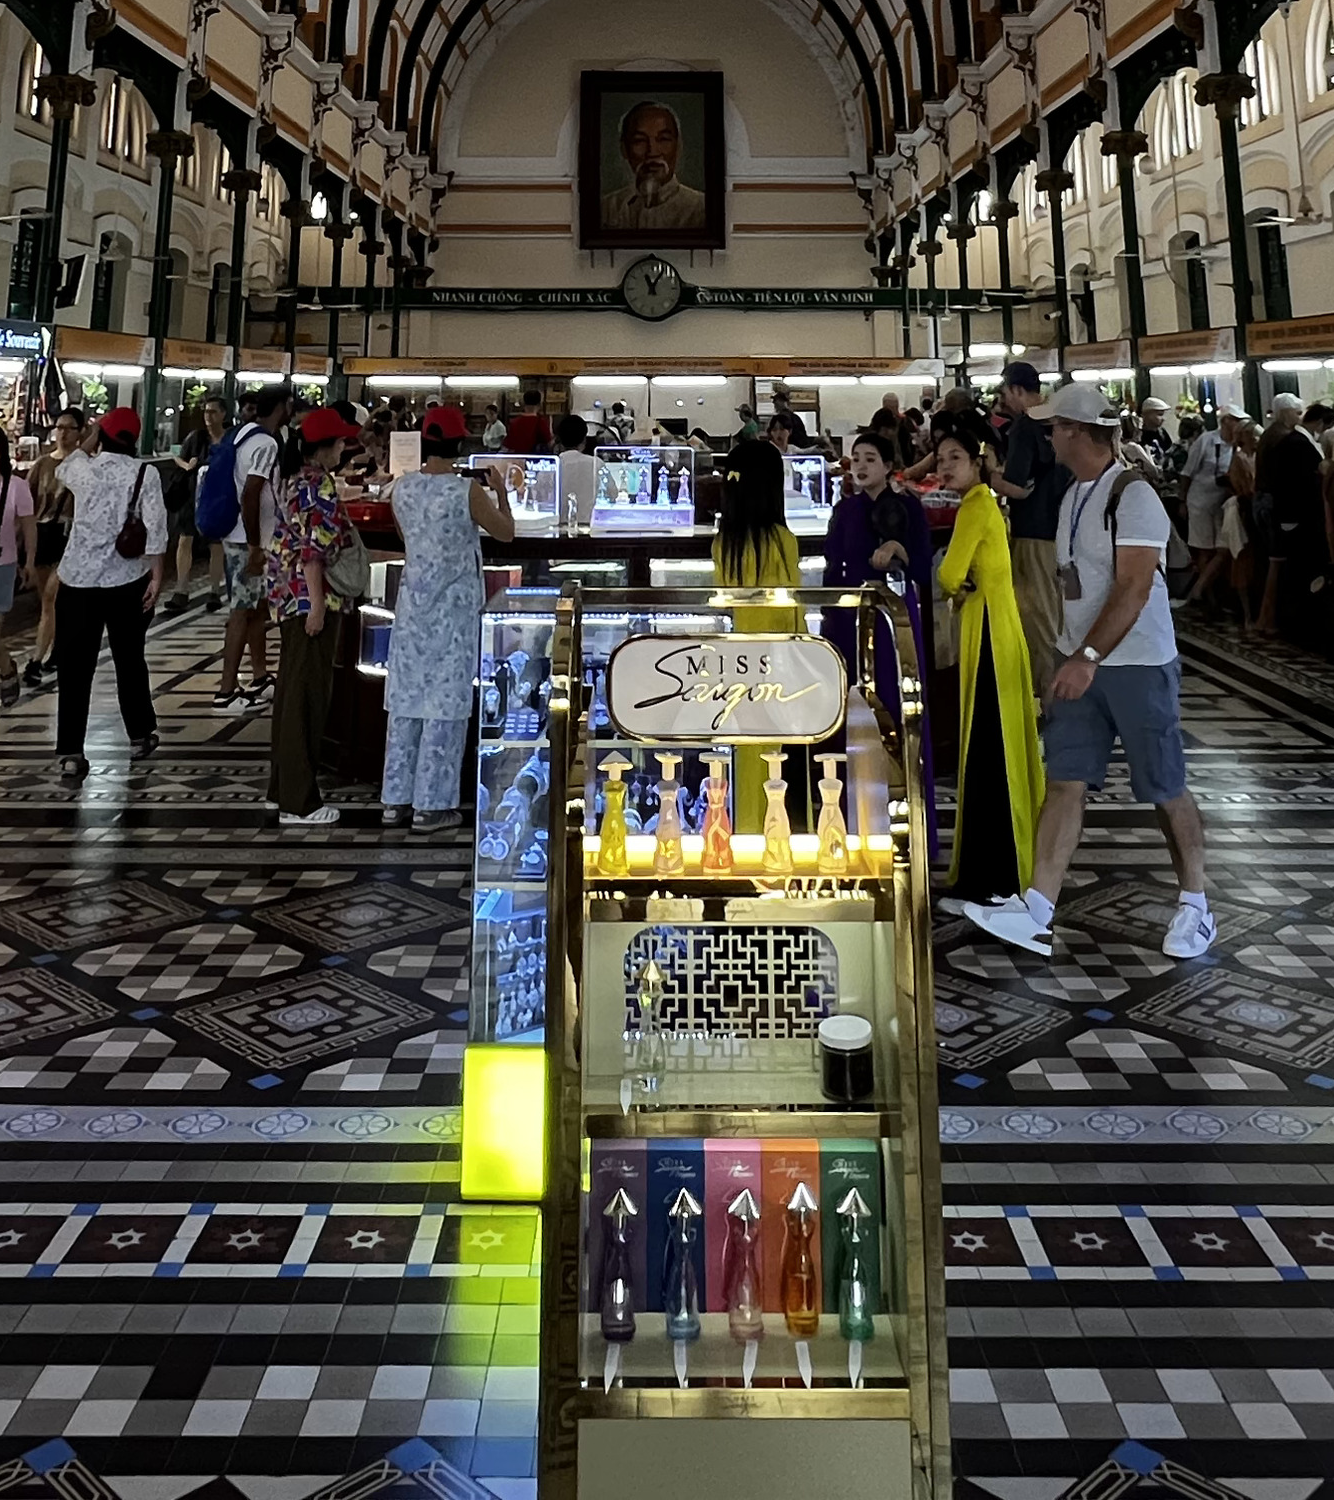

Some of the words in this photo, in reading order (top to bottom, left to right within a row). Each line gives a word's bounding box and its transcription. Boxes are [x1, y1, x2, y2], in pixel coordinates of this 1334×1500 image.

[432, 292, 475, 303] NHANH
[479, 290, 523, 303] CHÓNG
[538, 291, 581, 303] CHÍNH
[586, 291, 612, 303] XÁC
[841, 292, 874, 303] MINH
[686, 655, 772, 676] MISS
[633, 643, 822, 731] Saigon
